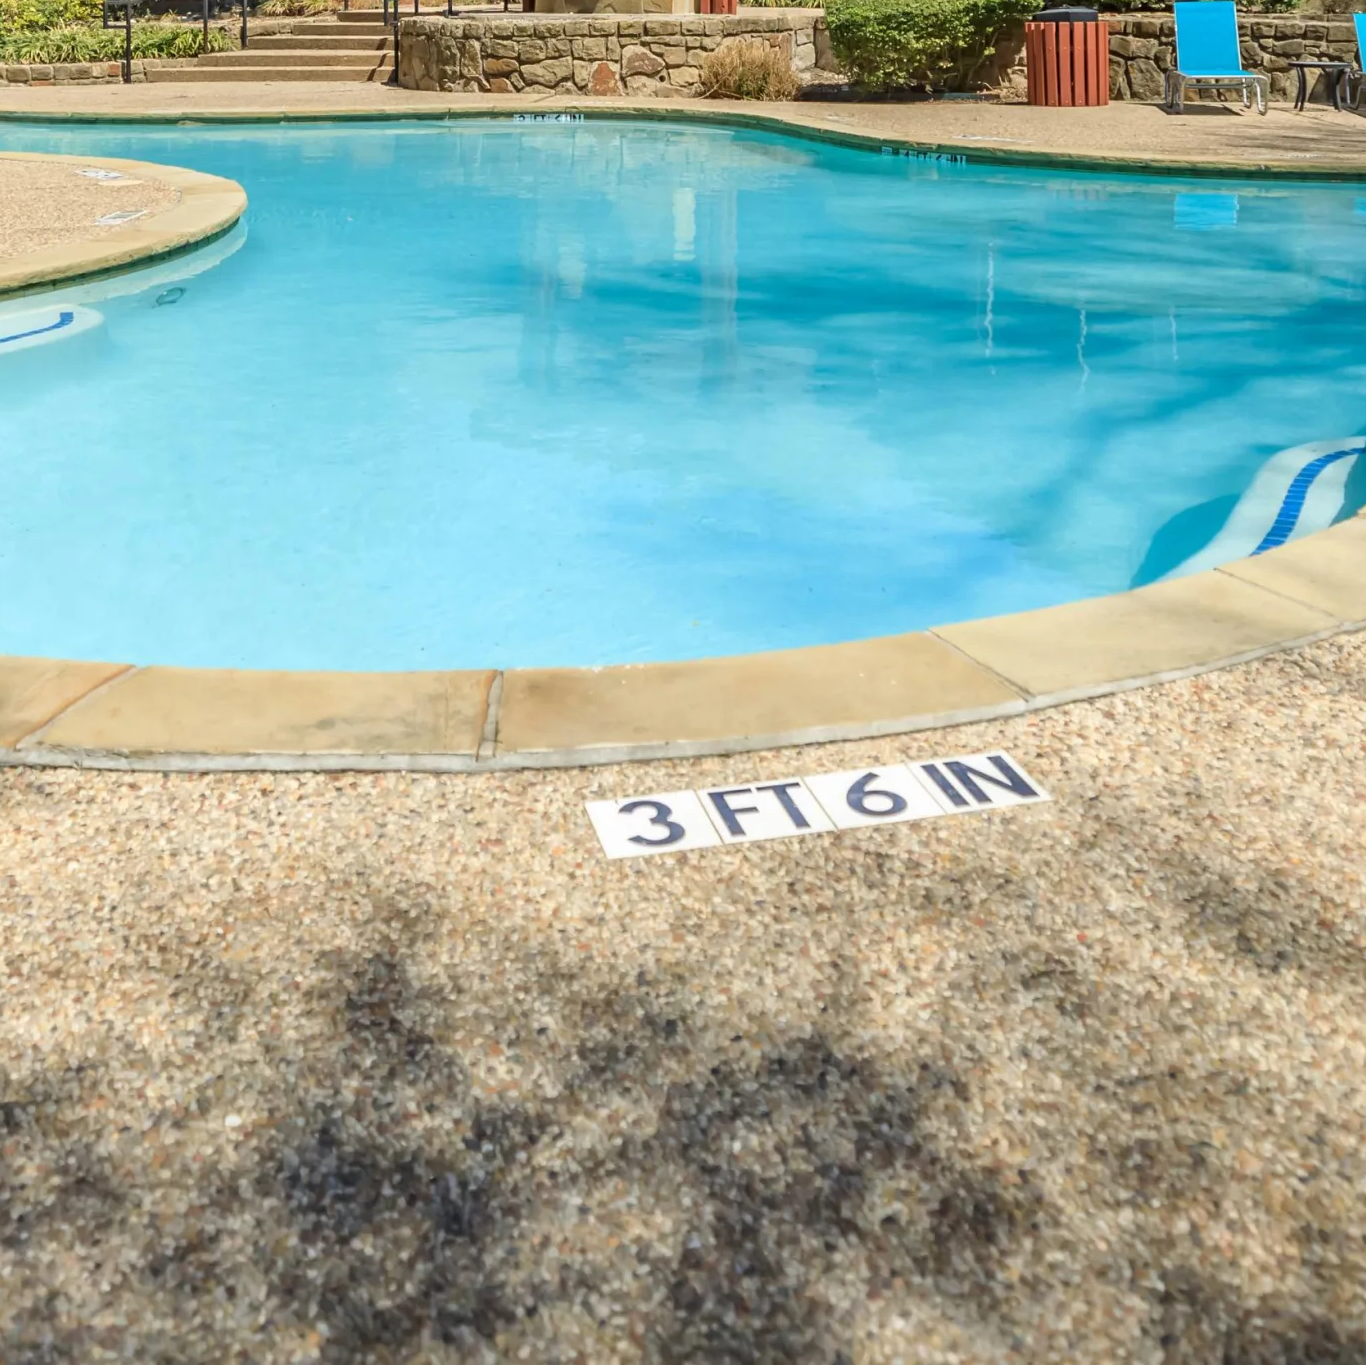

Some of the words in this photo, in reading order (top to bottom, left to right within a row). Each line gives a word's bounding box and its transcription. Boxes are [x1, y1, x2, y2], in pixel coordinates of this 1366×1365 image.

[618, 799, 686, 846] 3
[707, 781, 811, 836] FT
[845, 771, 908, 817] 6
[920, 754, 1041, 807] IN
